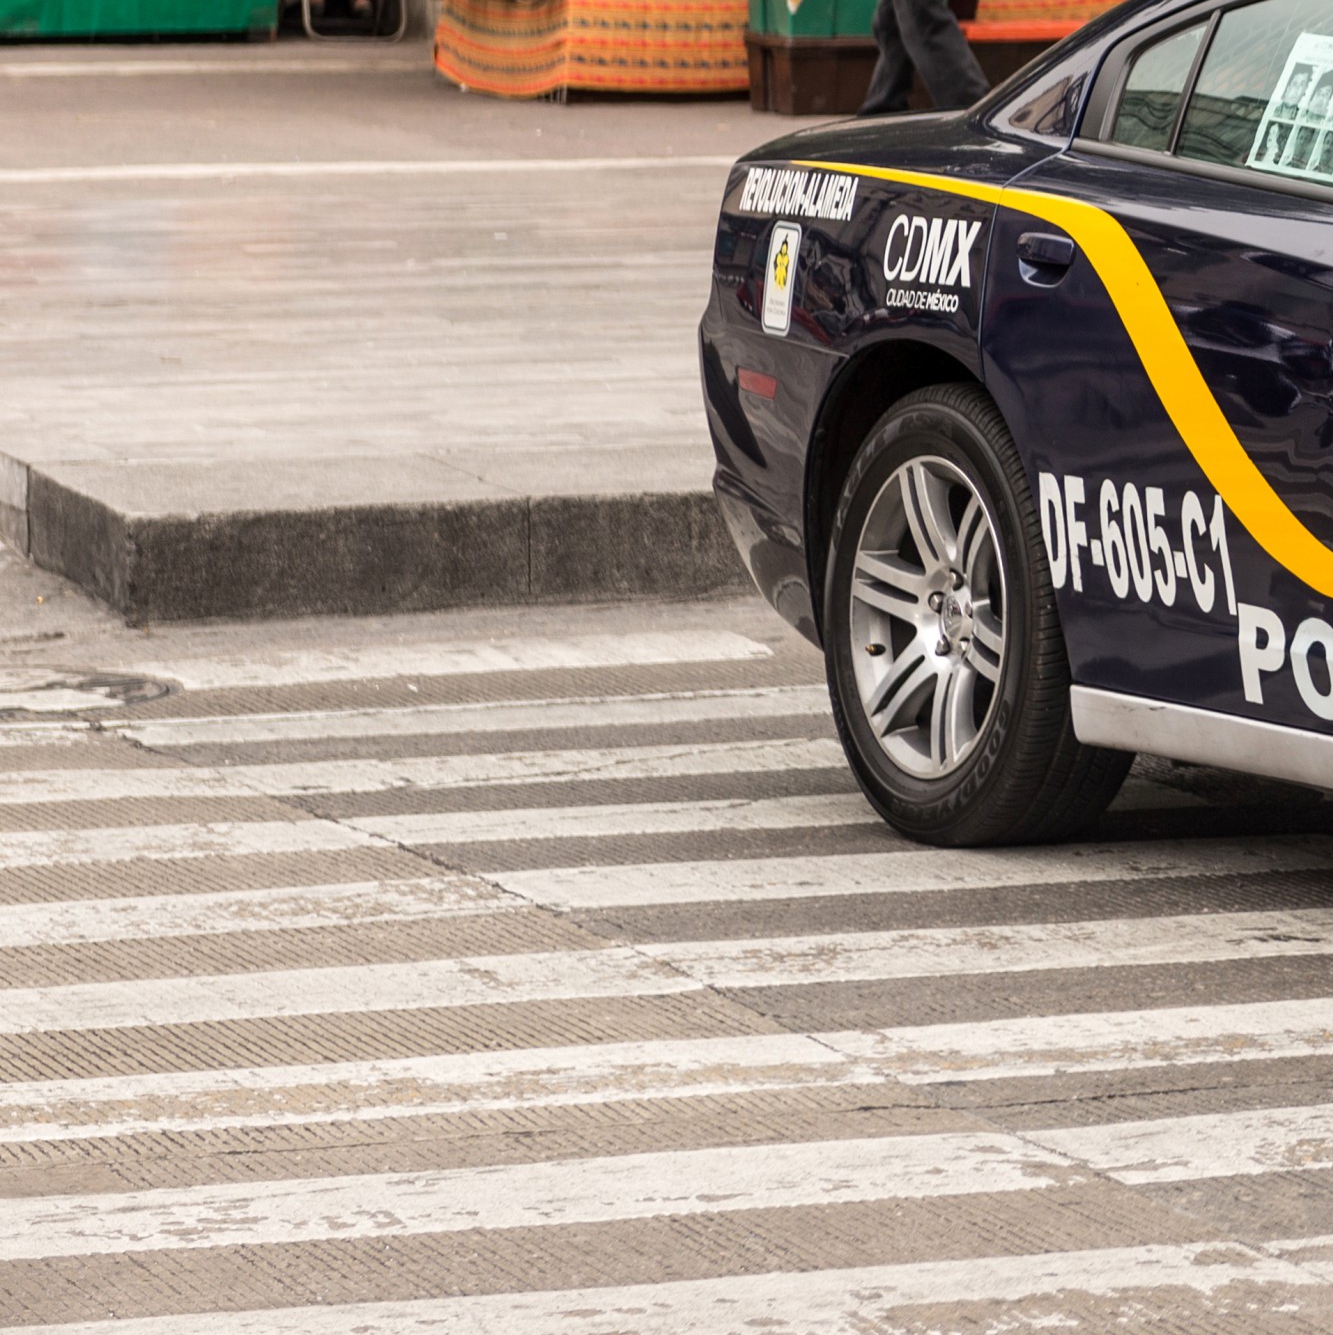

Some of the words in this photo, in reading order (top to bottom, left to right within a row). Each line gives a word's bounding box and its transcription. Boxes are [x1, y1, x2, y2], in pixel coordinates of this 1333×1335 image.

[739, 167, 859, 222] REVOLUCION-ALAMEDA
[883, 214, 982, 288] CDMX
[886, 288, 915, 307] CIUDAD
[914, 292, 927, 309] DE
[926, 288, 959, 313] MÉXICO
[1039, 472, 1239, 616] DF-605-C1
